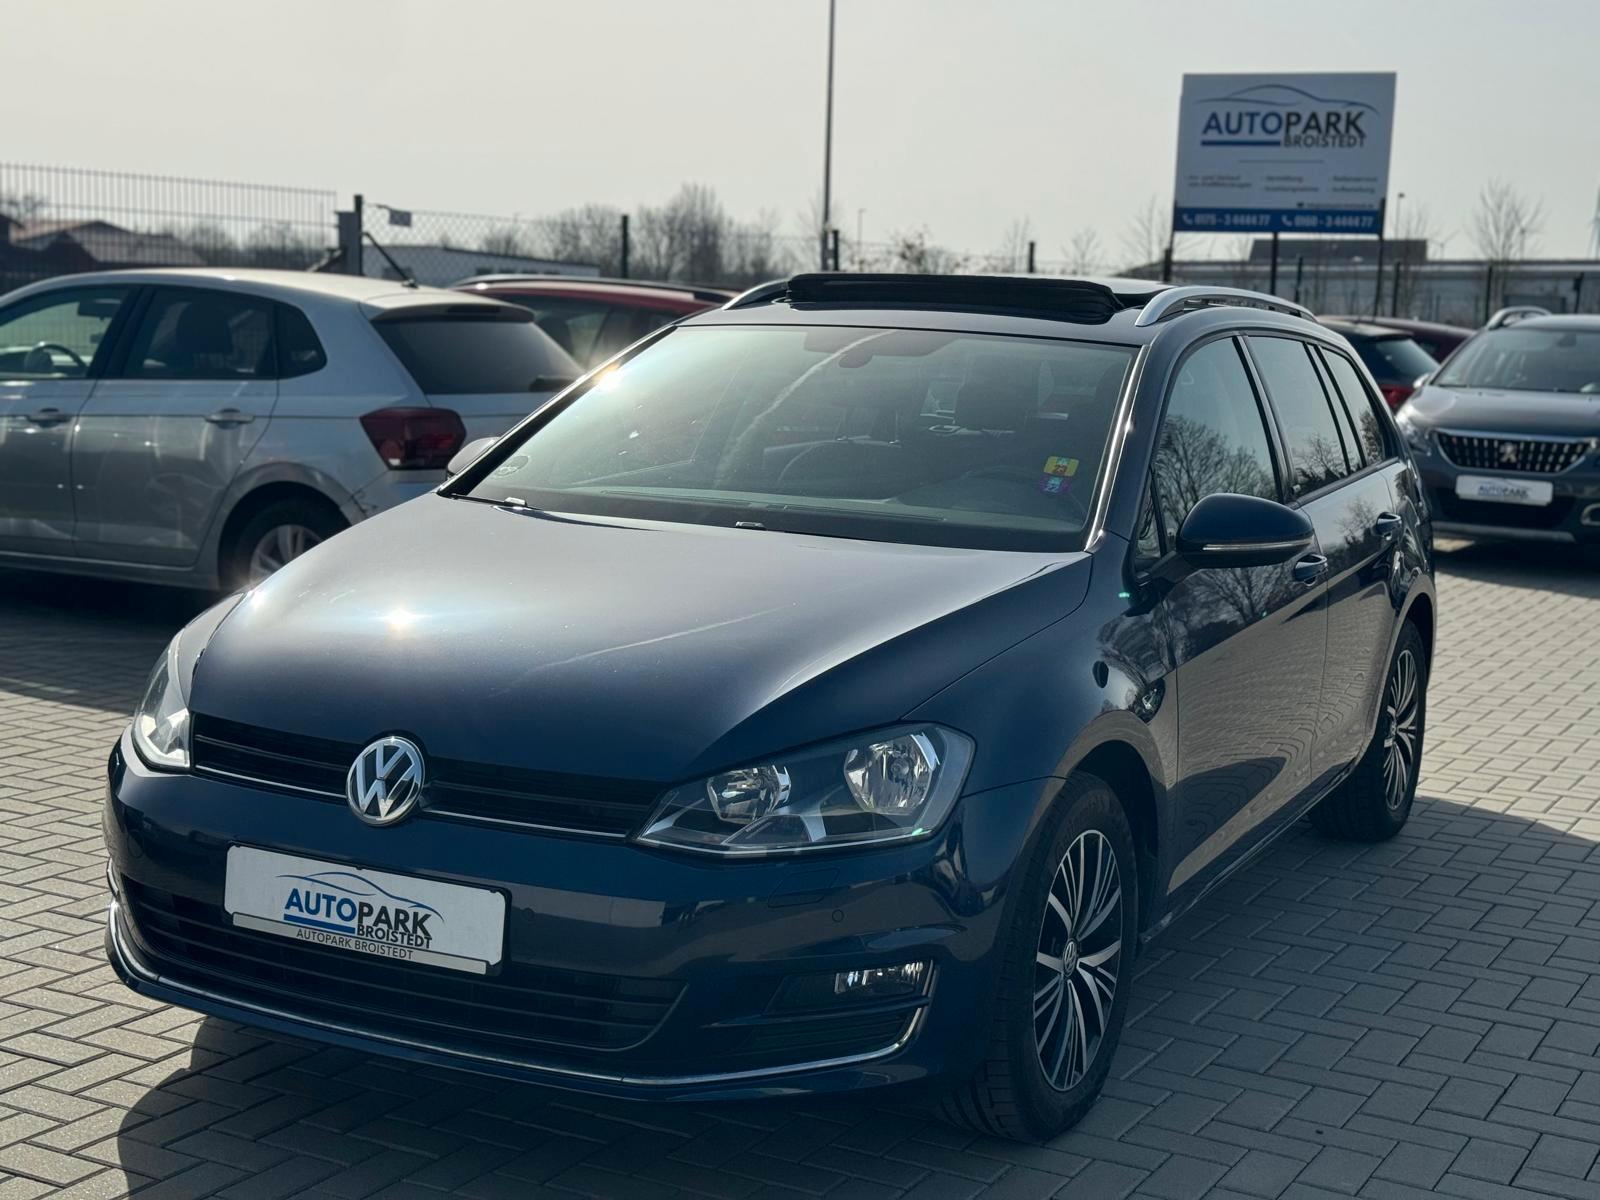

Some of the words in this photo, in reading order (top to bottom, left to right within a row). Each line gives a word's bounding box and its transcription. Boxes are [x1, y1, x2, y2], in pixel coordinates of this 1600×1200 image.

[1202, 111, 1365, 137] AUTOPARK
[1284, 134, 1367, 148] BROISTEDT
[350, 740, 421, 821] VW
[284, 887, 433, 937] AUTOPARK
[296, 928, 352, 948] AUTOPARK
[354, 940, 414, 960] BROISTEDT
[356, 924, 433, 949] BROISTEDT
